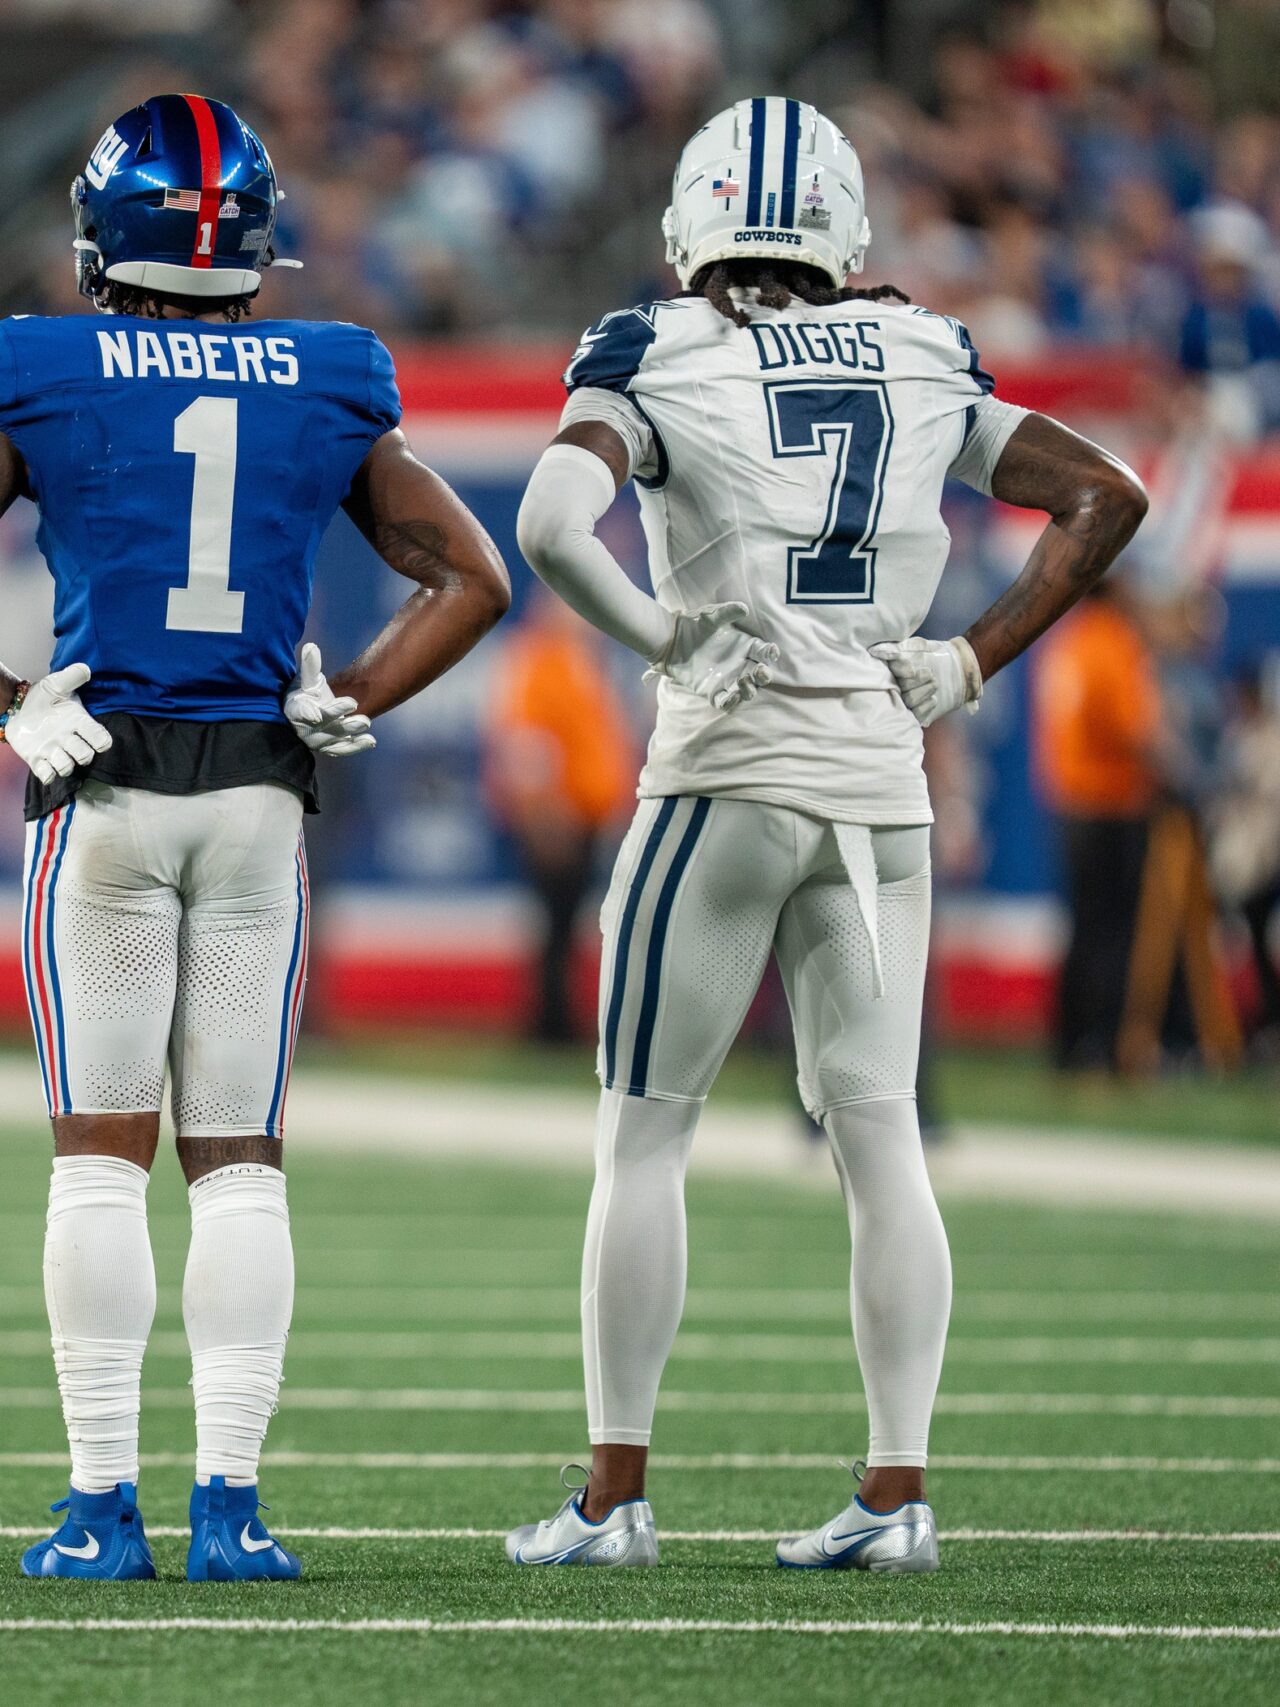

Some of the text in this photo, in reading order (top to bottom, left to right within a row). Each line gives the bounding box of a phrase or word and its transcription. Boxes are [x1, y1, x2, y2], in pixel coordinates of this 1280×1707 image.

[197, 222, 212, 255] 1
[734, 231, 802, 246] COWBOYS
[96, 331, 299, 386] NABERS
[749, 321, 885, 372] DIGGS
[165, 396, 247, 634] 1
[763, 379, 895, 605] 7
